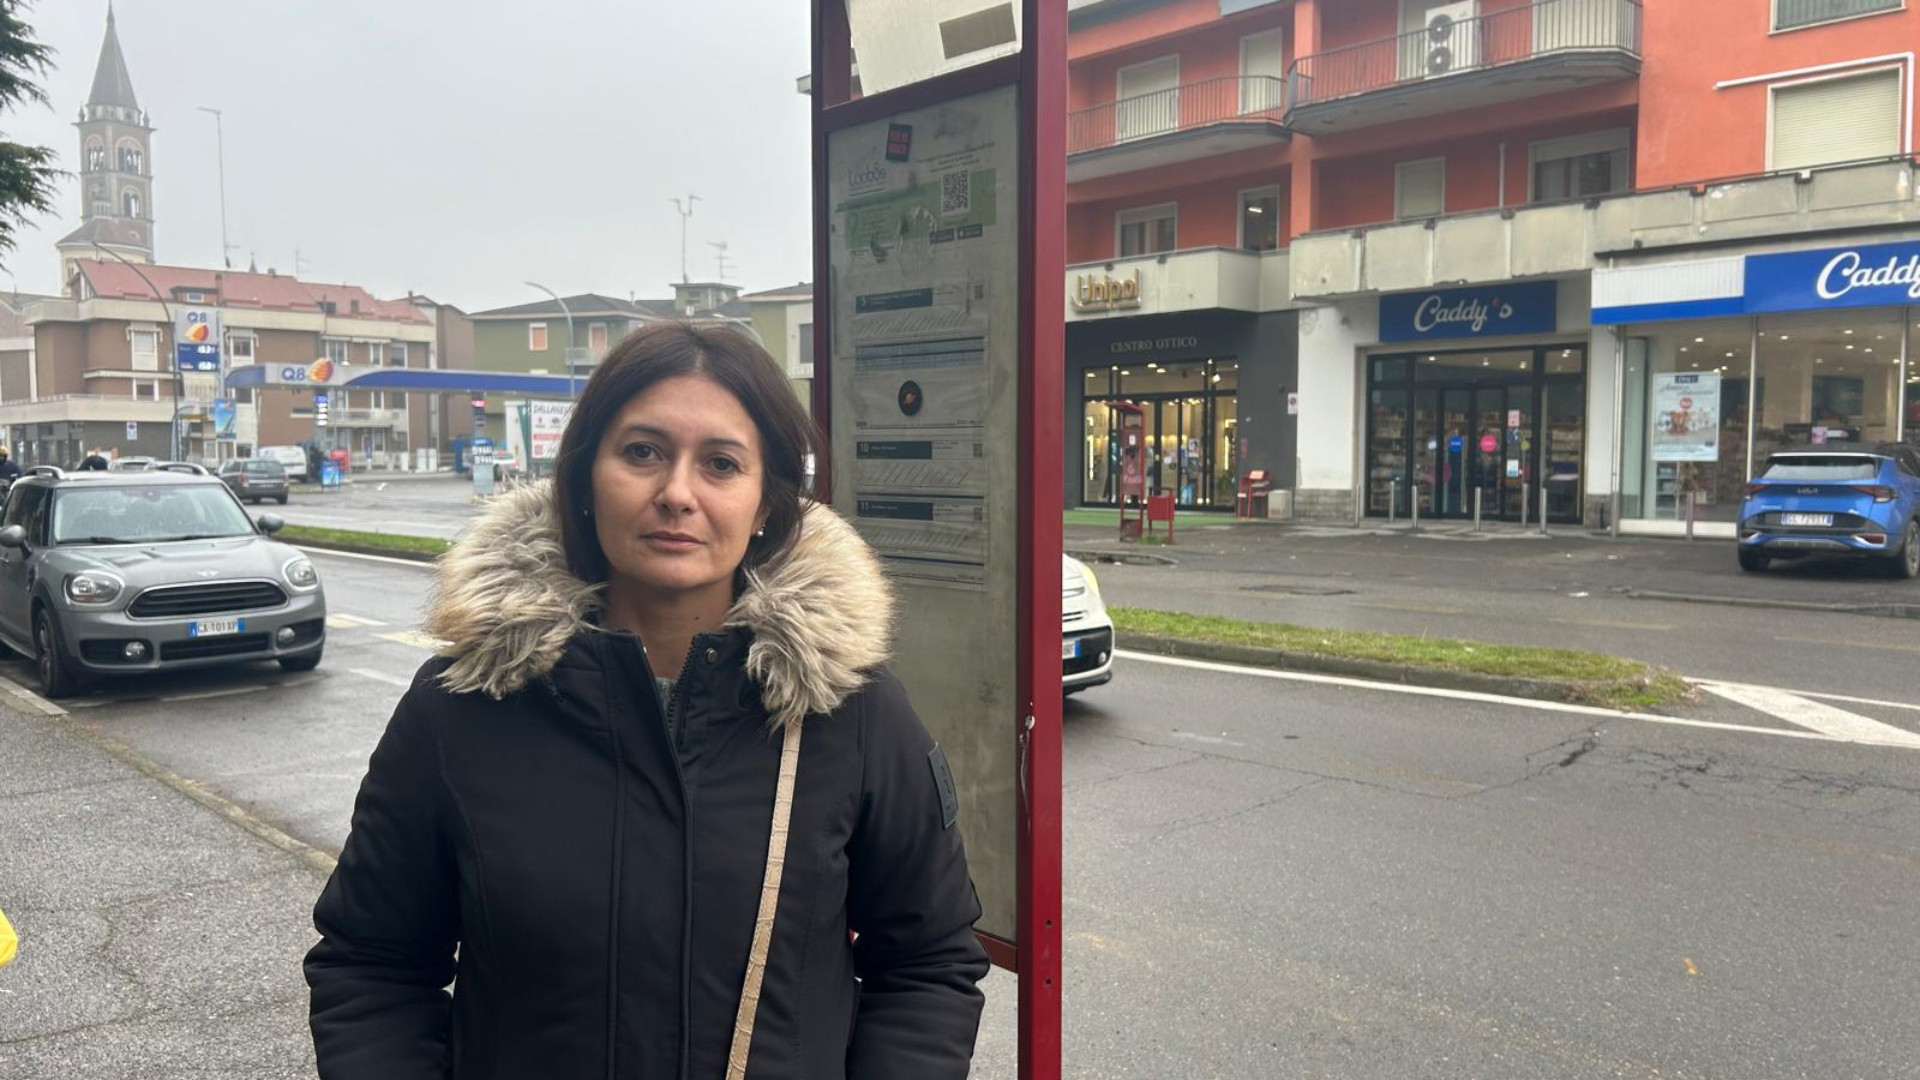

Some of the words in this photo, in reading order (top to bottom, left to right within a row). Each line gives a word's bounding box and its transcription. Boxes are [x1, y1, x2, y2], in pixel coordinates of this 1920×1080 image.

[1076, 268, 1140, 311] Unipol
[187, 311, 207, 323] Q8
[1110, 340, 1153, 353] CENTRO
[1155, 336, 1198, 349] OTTICO
[282, 367, 305, 381] Q8
